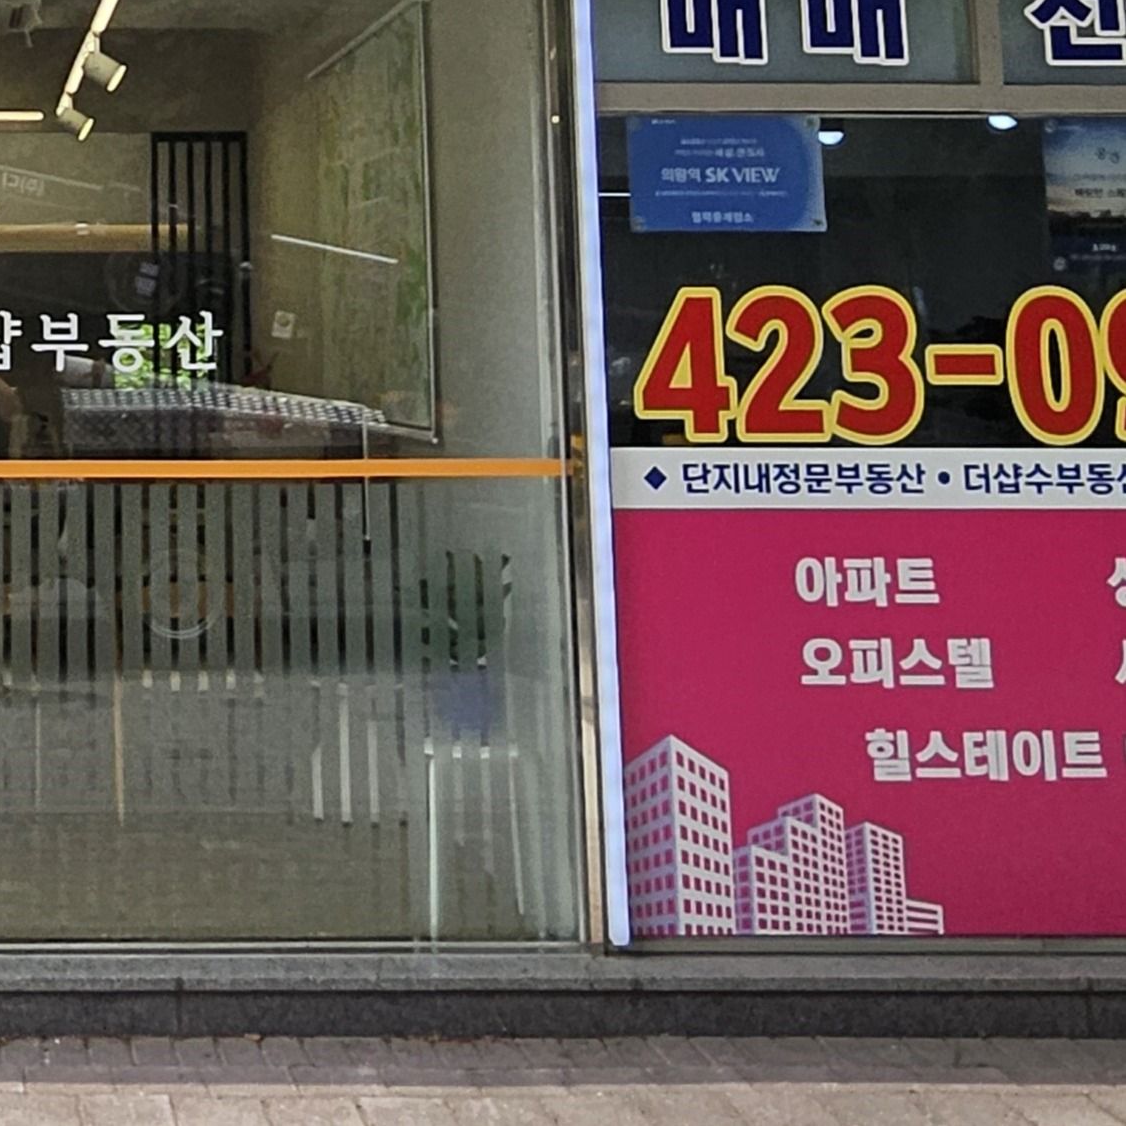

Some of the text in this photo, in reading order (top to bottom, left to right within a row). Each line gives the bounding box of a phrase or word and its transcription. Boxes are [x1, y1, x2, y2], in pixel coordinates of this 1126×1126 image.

[705, 167, 730, 183] SK
[731, 167, 780, 183] VIEW
[633, 284, 1126, 446] 423-0
[682, 462, 926, 495] 단지내정문부동산
[795, 557, 941, 607] 아파트
[801, 638, 995, 689] 오피스텔
[865, 728, 1108, 782] 힐스테이트
